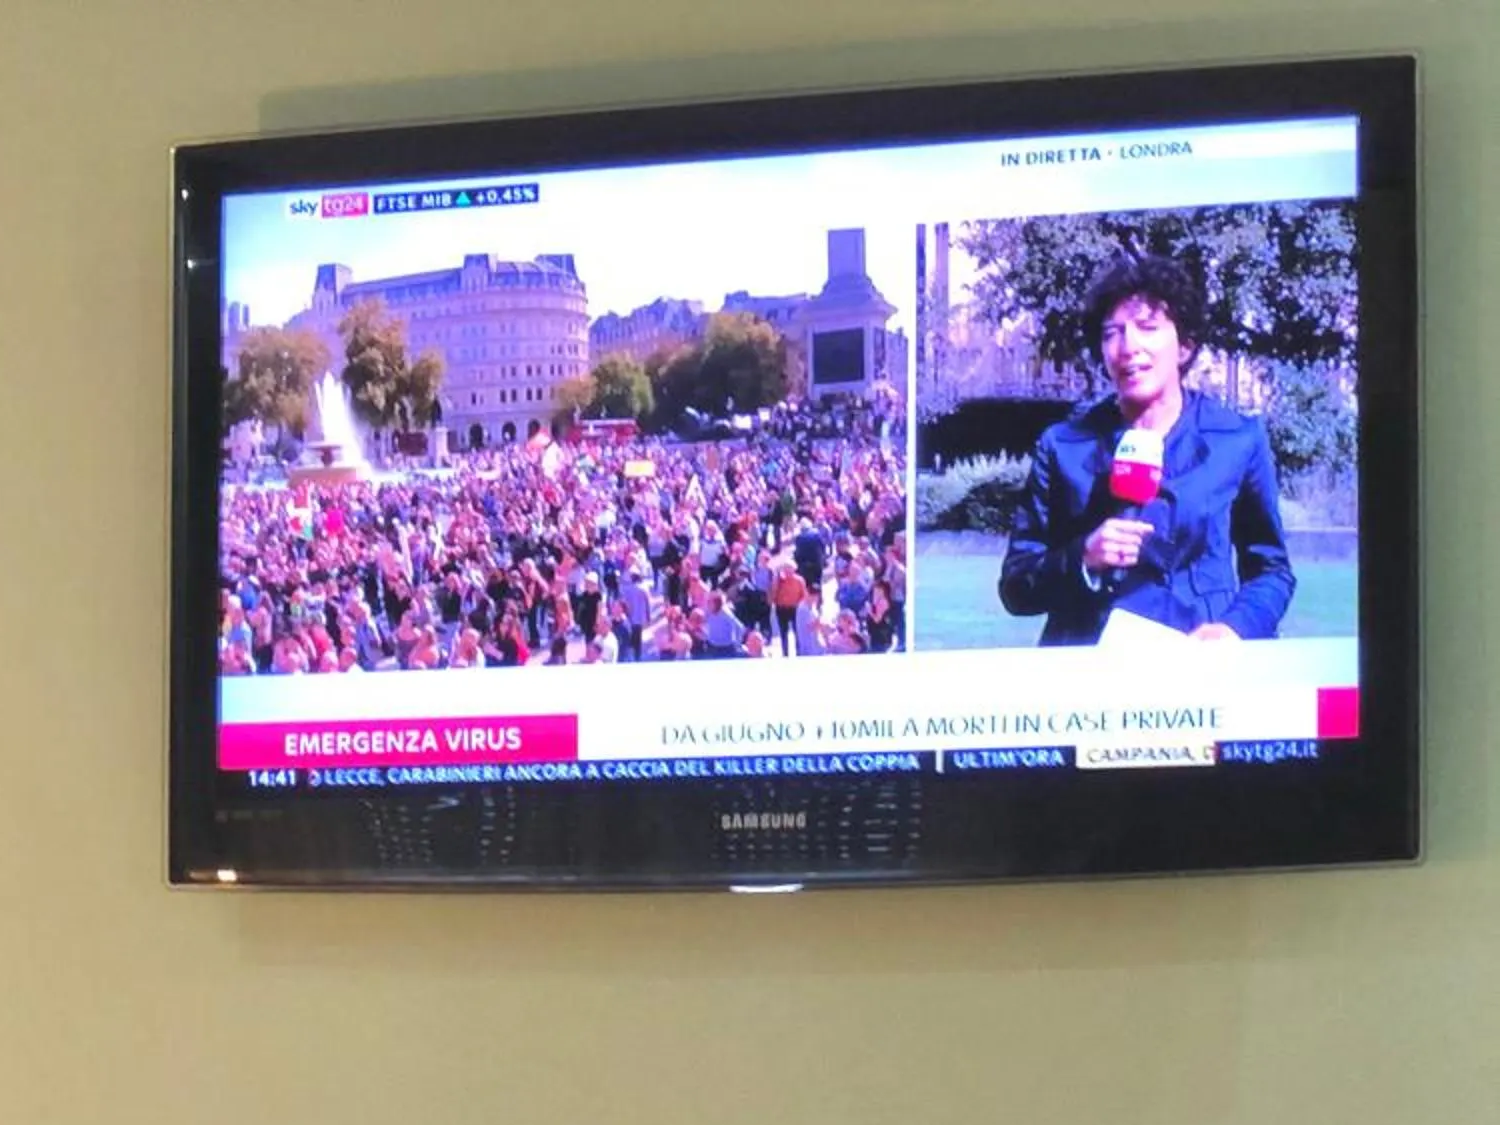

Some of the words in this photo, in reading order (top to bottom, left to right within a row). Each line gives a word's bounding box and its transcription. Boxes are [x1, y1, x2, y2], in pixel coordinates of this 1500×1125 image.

[1000, 151, 1020, 167] IN
[1025, 147, 1101, 165] DIRETTA
[1119, 141, 1193, 159] LONDRA
[289, 199, 318, 217] sky
[377, 197, 417, 212] FTSE
[421, 193, 452, 208] MIB
[661, 724, 696, 745] DA
[702, 720, 805, 744] GIUGNO
[1015, 714, 1041, 734] IN
[1047, 710, 1108, 733] CASE
[1122, 707, 1222, 729] PRIVATE
[284, 730, 438, 757] EMERGENZA
[445, 727, 522, 751] VIRUS
[1222, 740, 1318, 763] skytg24.it
[248, 769, 297, 787] 14:41
[324, 768, 386, 787] LECCE,
[387, 764, 501, 785] CARABINIERI
[503, 763, 582, 782] ANCORA
[587, 762, 601, 780] A
[602, 760, 671, 780] CACCIA
[673, 758, 708, 777] DEL
[713, 755, 780, 776] KILLER
[782, 753, 845, 774] DELLA
[846, 751, 921, 772] COPPIA
[721, 812, 807, 830] SAMSUNG
